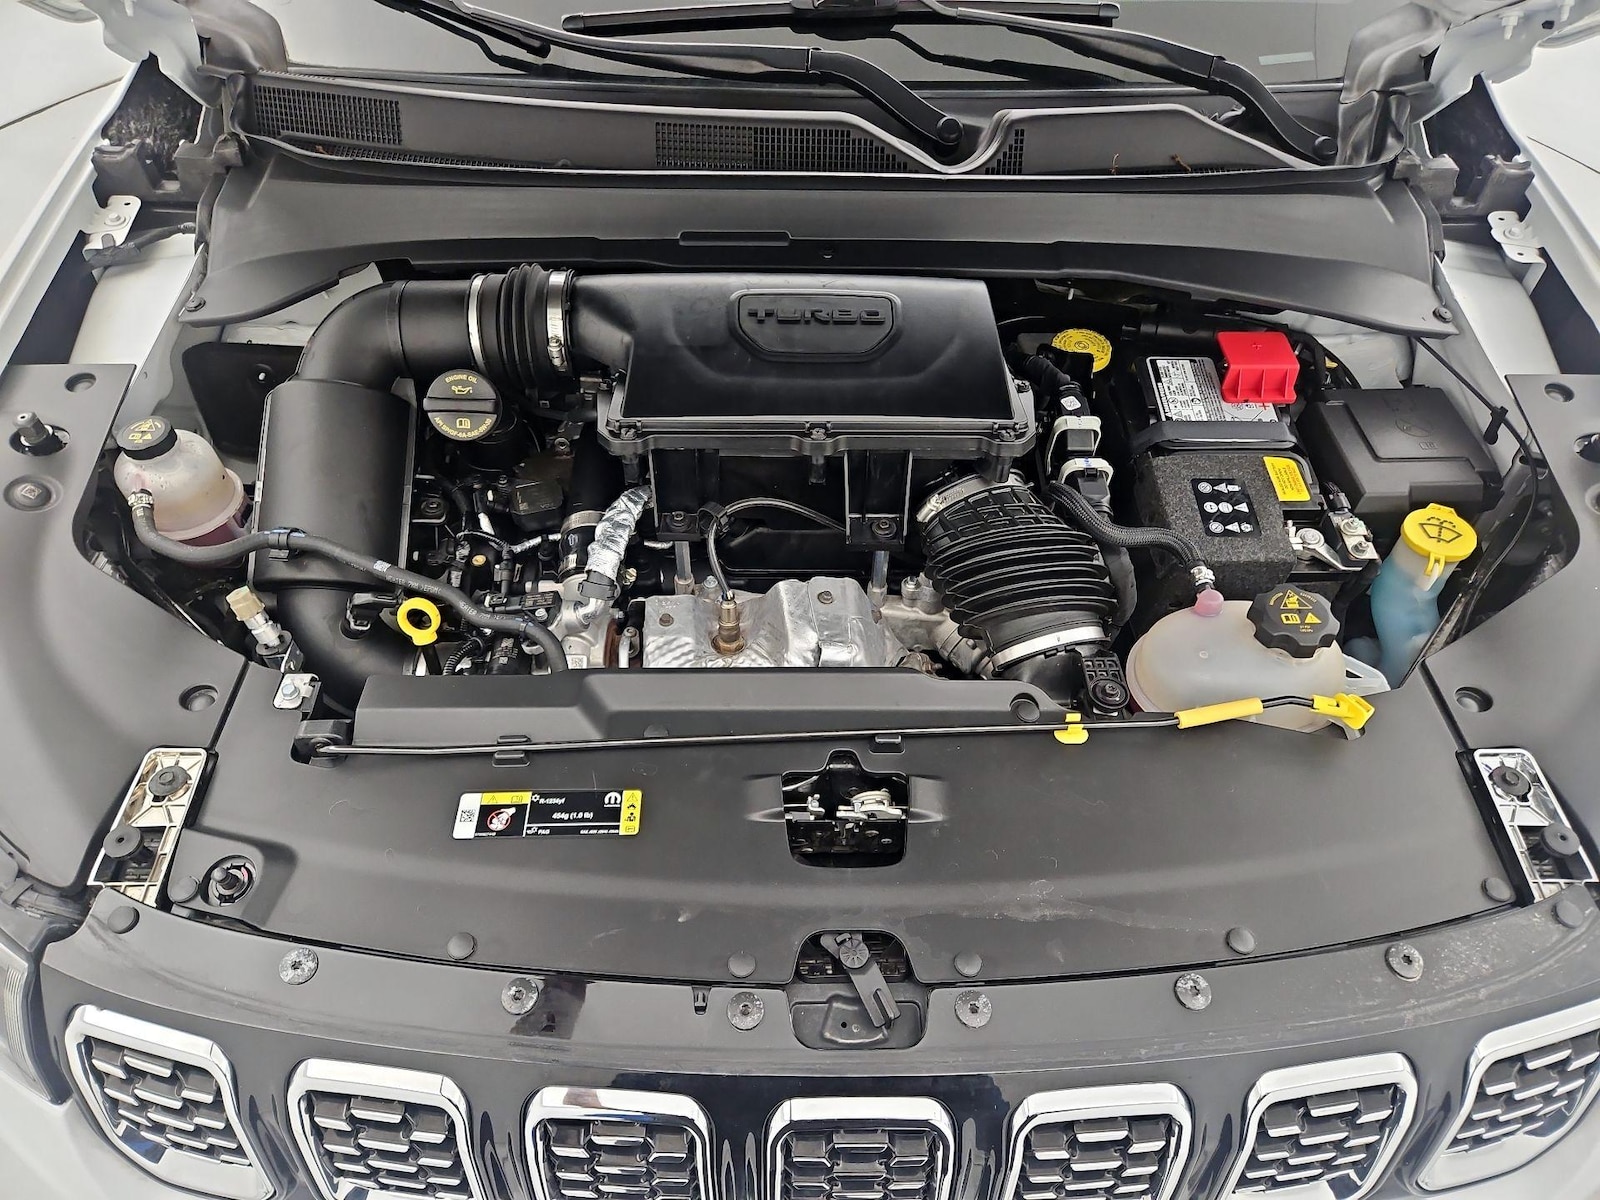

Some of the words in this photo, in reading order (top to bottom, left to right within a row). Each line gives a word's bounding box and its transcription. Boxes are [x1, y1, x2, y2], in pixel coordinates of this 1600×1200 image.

[748, 308, 886, 325] TURBO
[445, 374, 468, 384] ENGINE
[467, 375, 478, 384] OIL
[552, 812, 570, 820] 454g
[570, 812, 584, 820] (1.0
[583, 812, 594, 820] lb)
